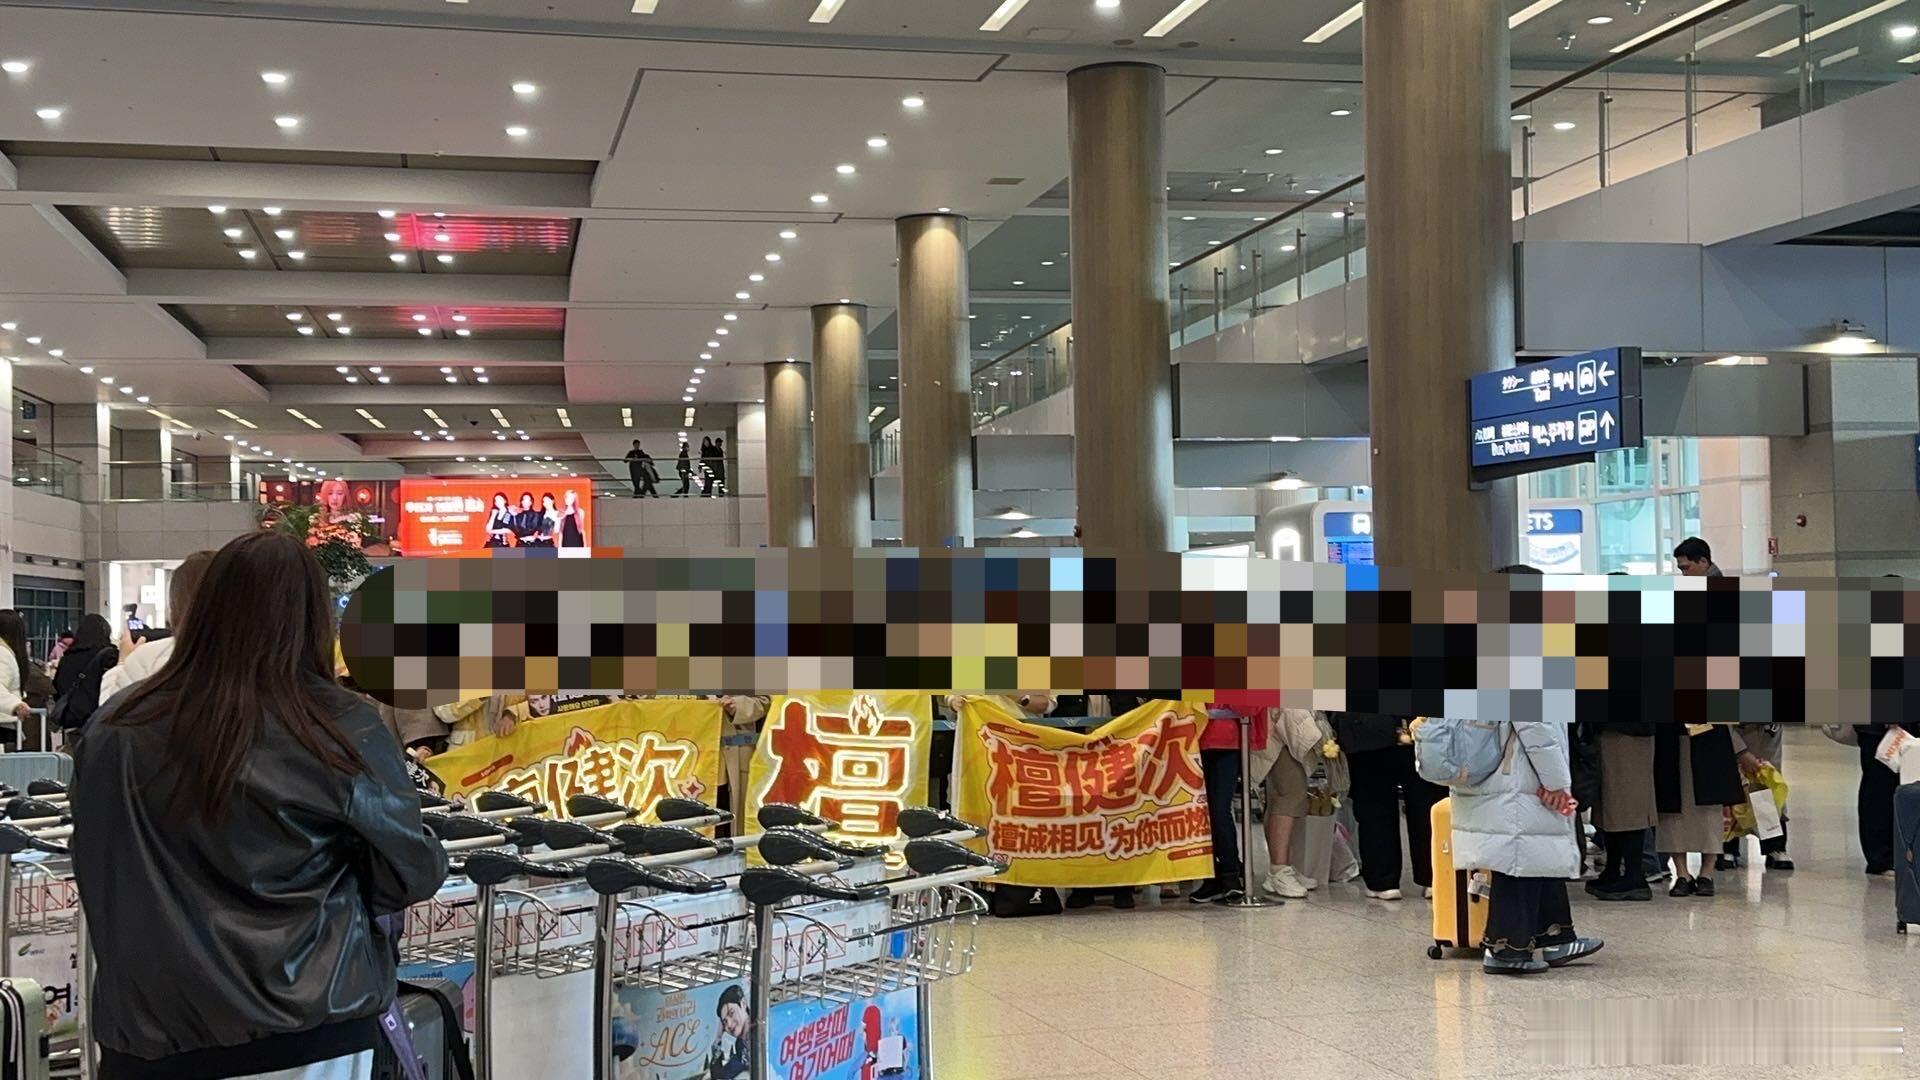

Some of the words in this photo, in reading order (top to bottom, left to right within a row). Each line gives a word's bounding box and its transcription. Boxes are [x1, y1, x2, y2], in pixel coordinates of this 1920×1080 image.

[1492, 443, 1505, 456] Bus
[1505, 440, 1530, 455] Parking
[758, 699, 914, 847] 檀
[990, 717, 1204, 817] 檀健次
[992, 820, 1104, 854] 檀诚相见
[1110, 806, 1211, 855] 为你而燃
[640, 1018, 701, 1066] ACE
[780, 1005, 849, 1065] 여행할때
[789, 1029, 856, 1080] 여기어때
